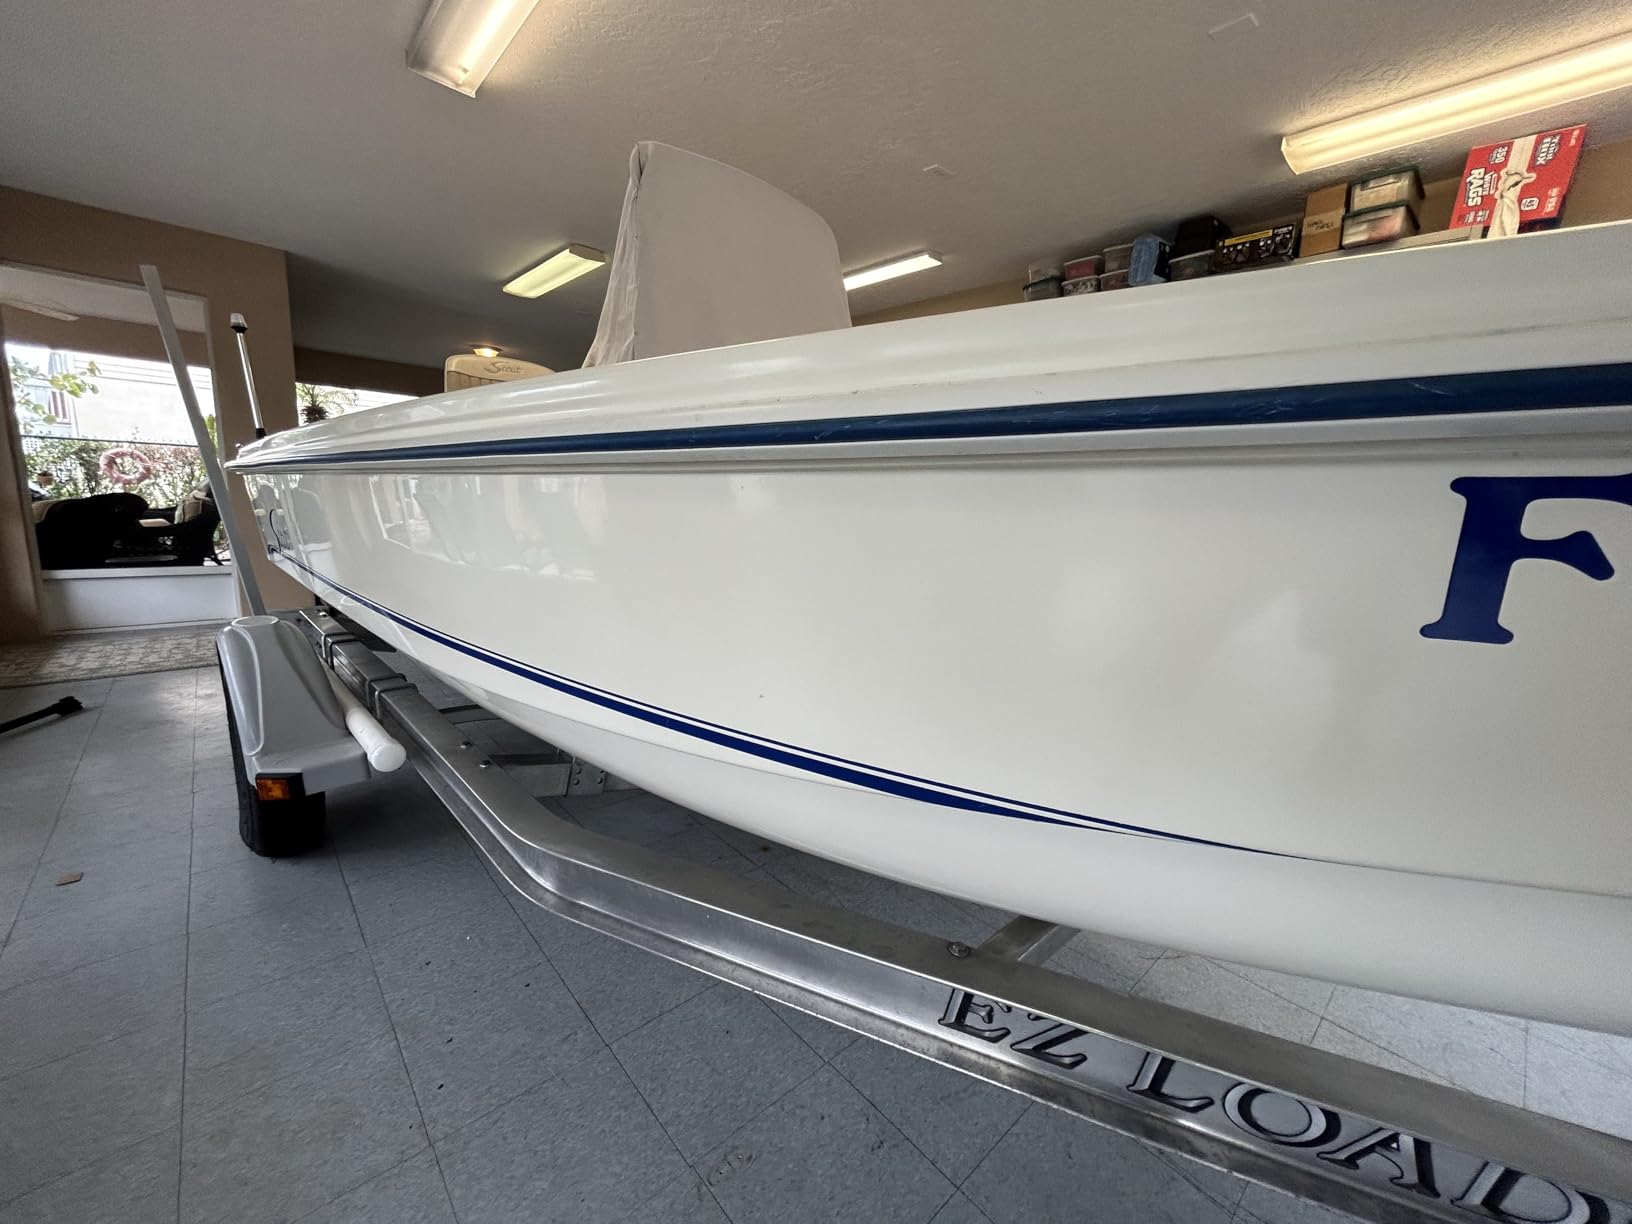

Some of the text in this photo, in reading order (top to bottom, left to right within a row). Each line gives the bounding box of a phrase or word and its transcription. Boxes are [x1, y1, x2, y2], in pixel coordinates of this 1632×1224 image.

[1495, 146, 1508, 163] 350
[1466, 168, 1485, 206] RAGS
[484, 361, 521, 374] Scout
[938, 988, 1089, 1069] EZ
